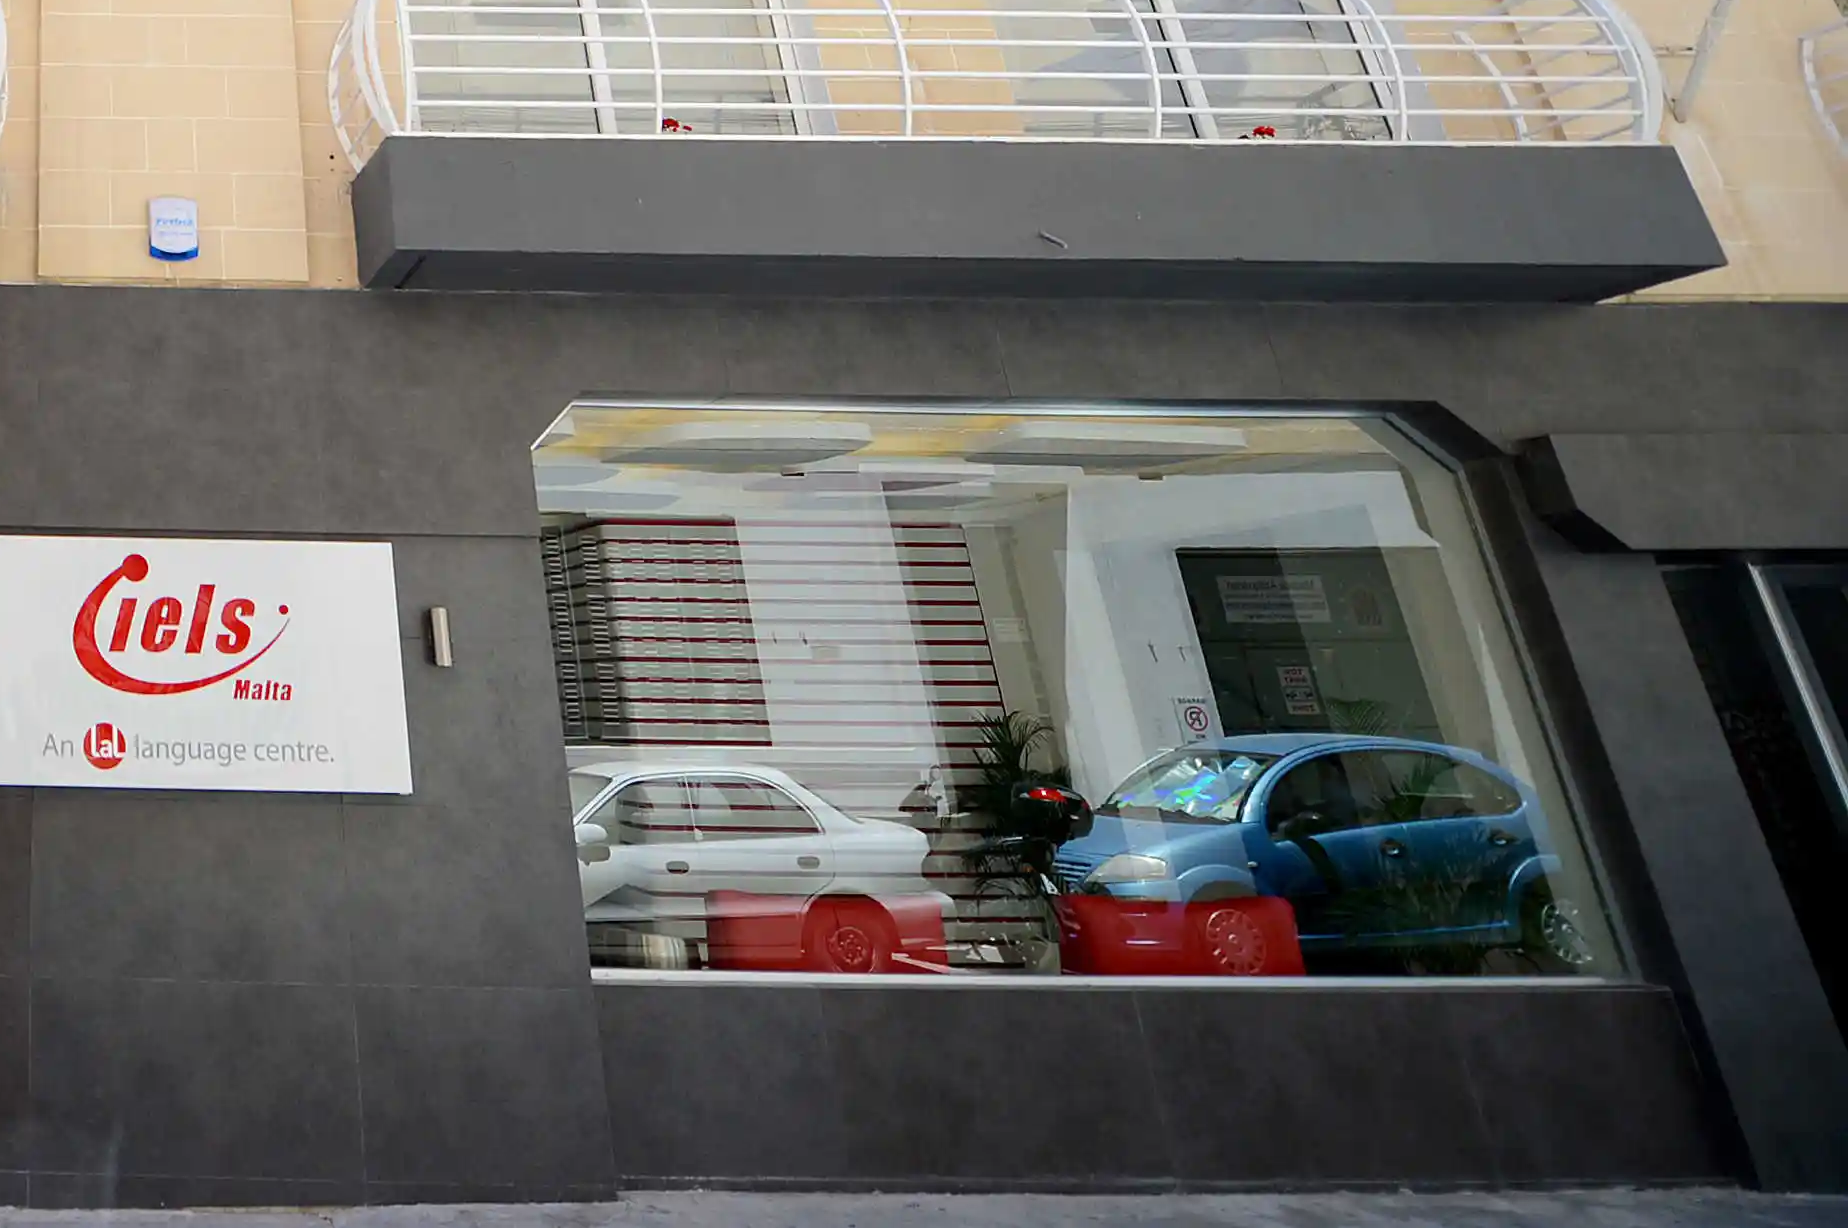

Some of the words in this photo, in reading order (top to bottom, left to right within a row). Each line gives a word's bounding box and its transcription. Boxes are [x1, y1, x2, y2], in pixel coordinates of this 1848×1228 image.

[233, 678, 293, 702] Malta
[42, 733, 75, 757] An
[134, 733, 247, 766] language
[253, 738, 335, 763] centre.
